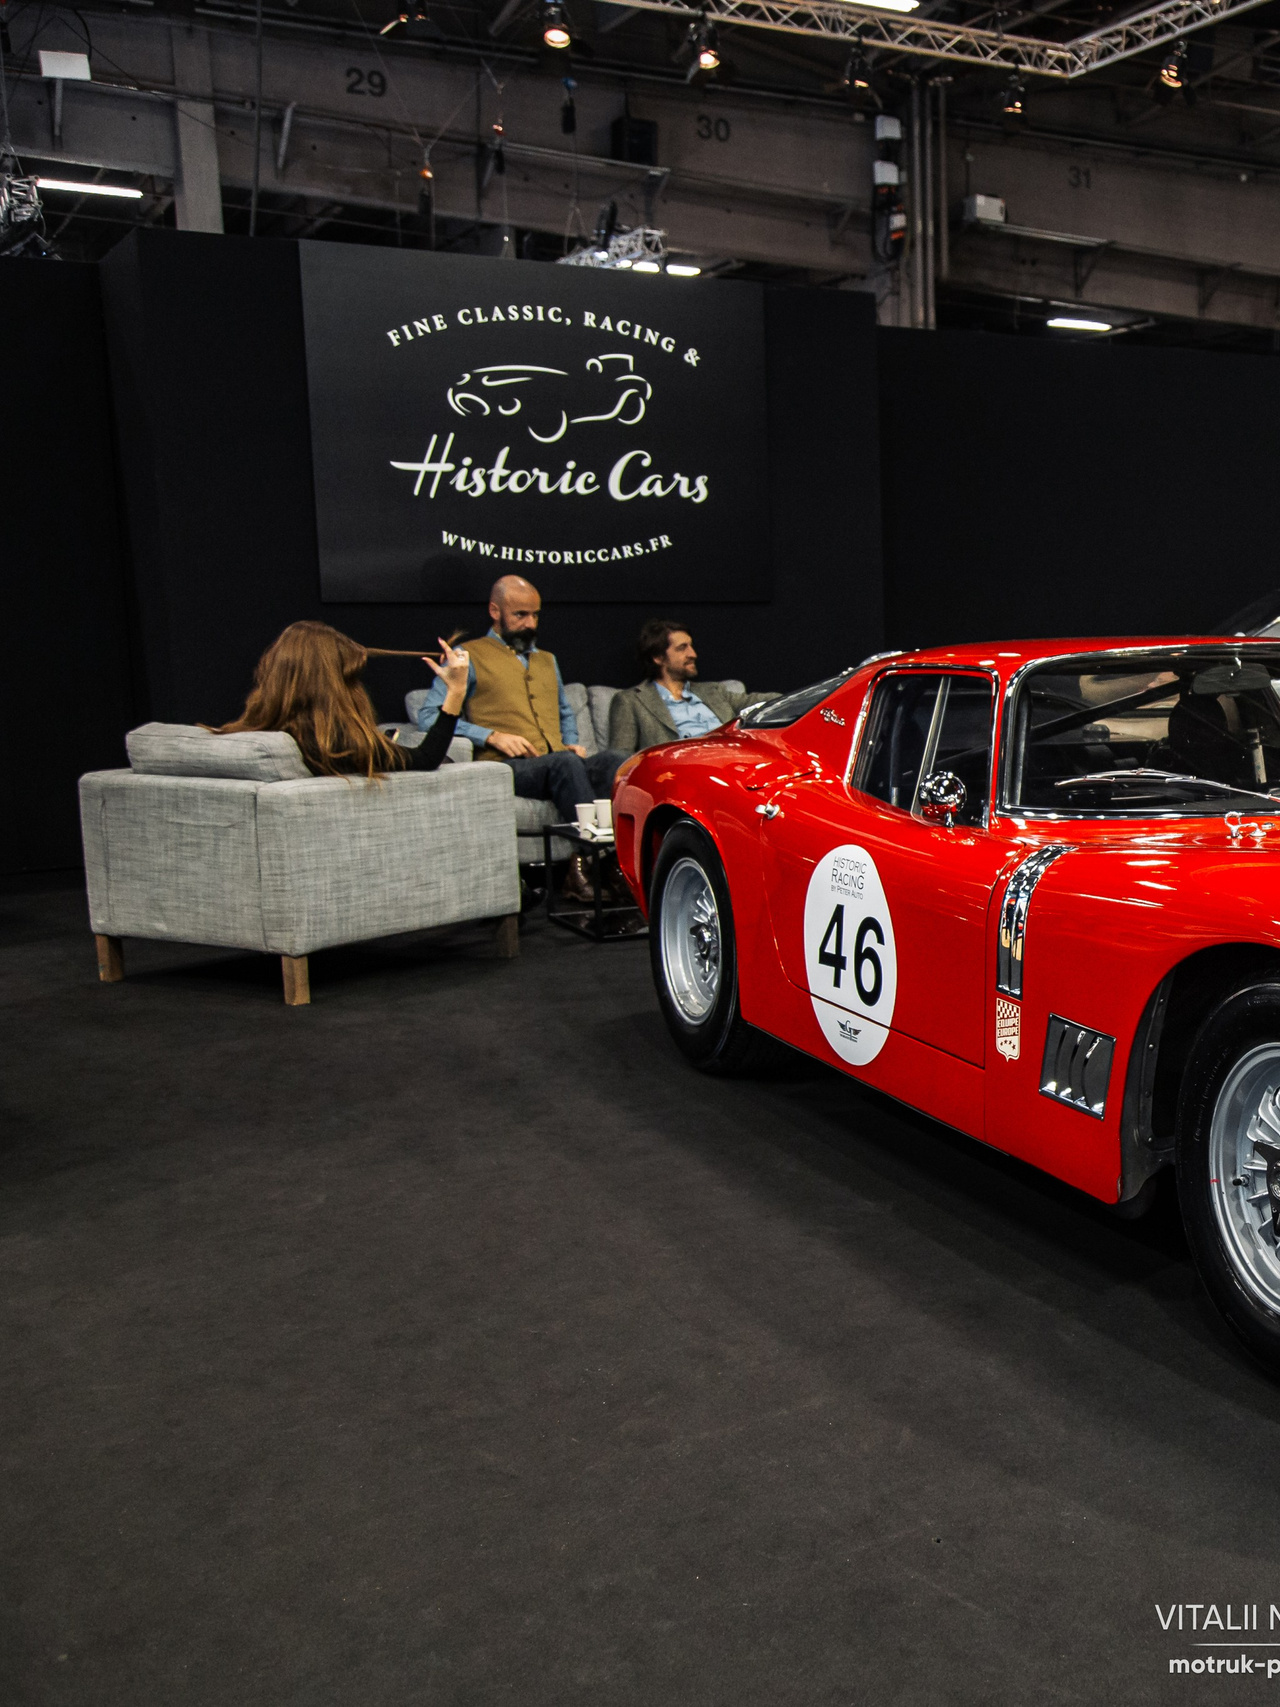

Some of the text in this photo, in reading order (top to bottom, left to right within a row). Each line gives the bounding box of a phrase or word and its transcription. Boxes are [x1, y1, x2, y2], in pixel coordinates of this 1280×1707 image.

[345, 67, 387, 97] 29
[696, 115, 730, 142] 30
[386, 304, 700, 367] FINE CLASSIC, RACING &
[390, 432, 708, 503] Historic Cars
[442, 530, 673, 564] WWW.HISTORICCARS.FR
[831, 867, 865, 890] RACING
[833, 856, 867, 874] HISTORIC
[818, 903, 886, 1007] 46
[997, 1027, 1019, 1038] EUROPE
